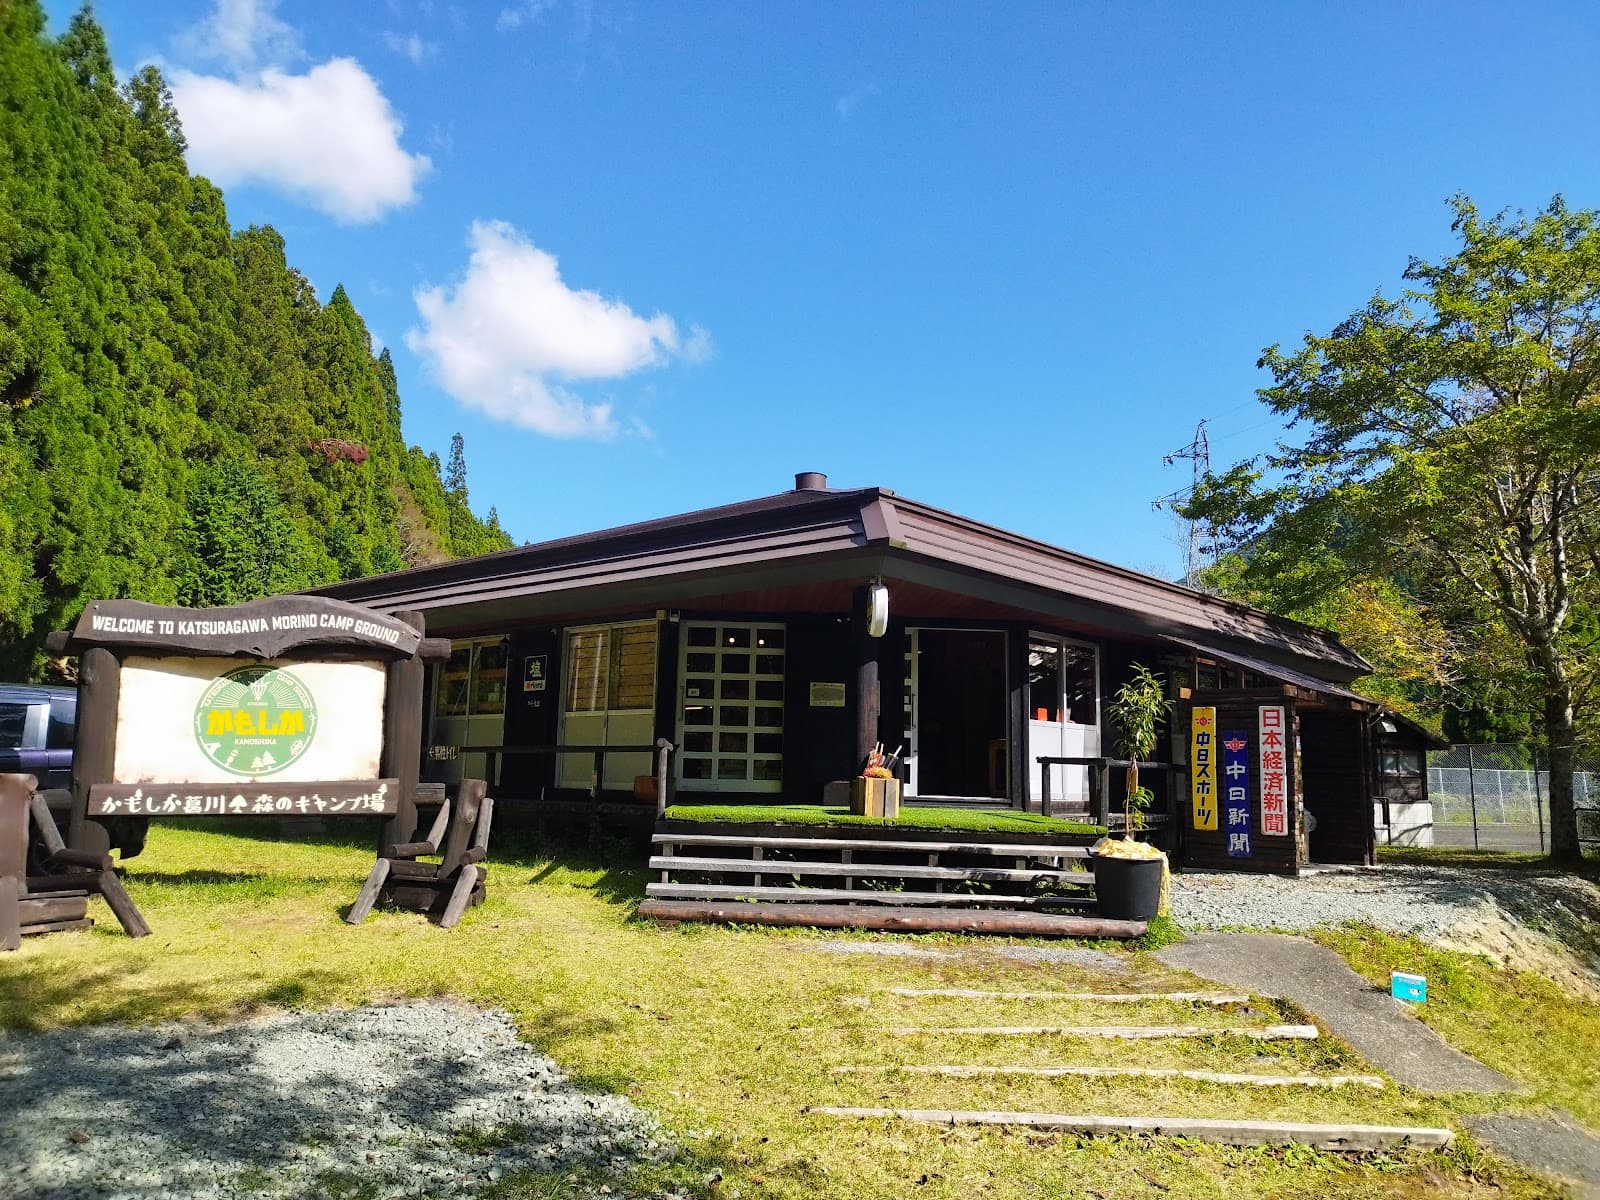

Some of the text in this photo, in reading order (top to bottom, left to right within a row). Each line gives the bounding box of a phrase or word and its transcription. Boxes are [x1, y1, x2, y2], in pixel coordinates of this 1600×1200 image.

[93, 613, 400, 644] WELCOME TO KATSURAGAWA MORINO CAMP GROUND
[206, 708, 305, 737] かもしか
[234, 737, 277, 746] KAMOSHIKA
[1261, 709, 1285, 833] 日本経済新聞
[1226, 760, 1250, 853] 中日新聞
